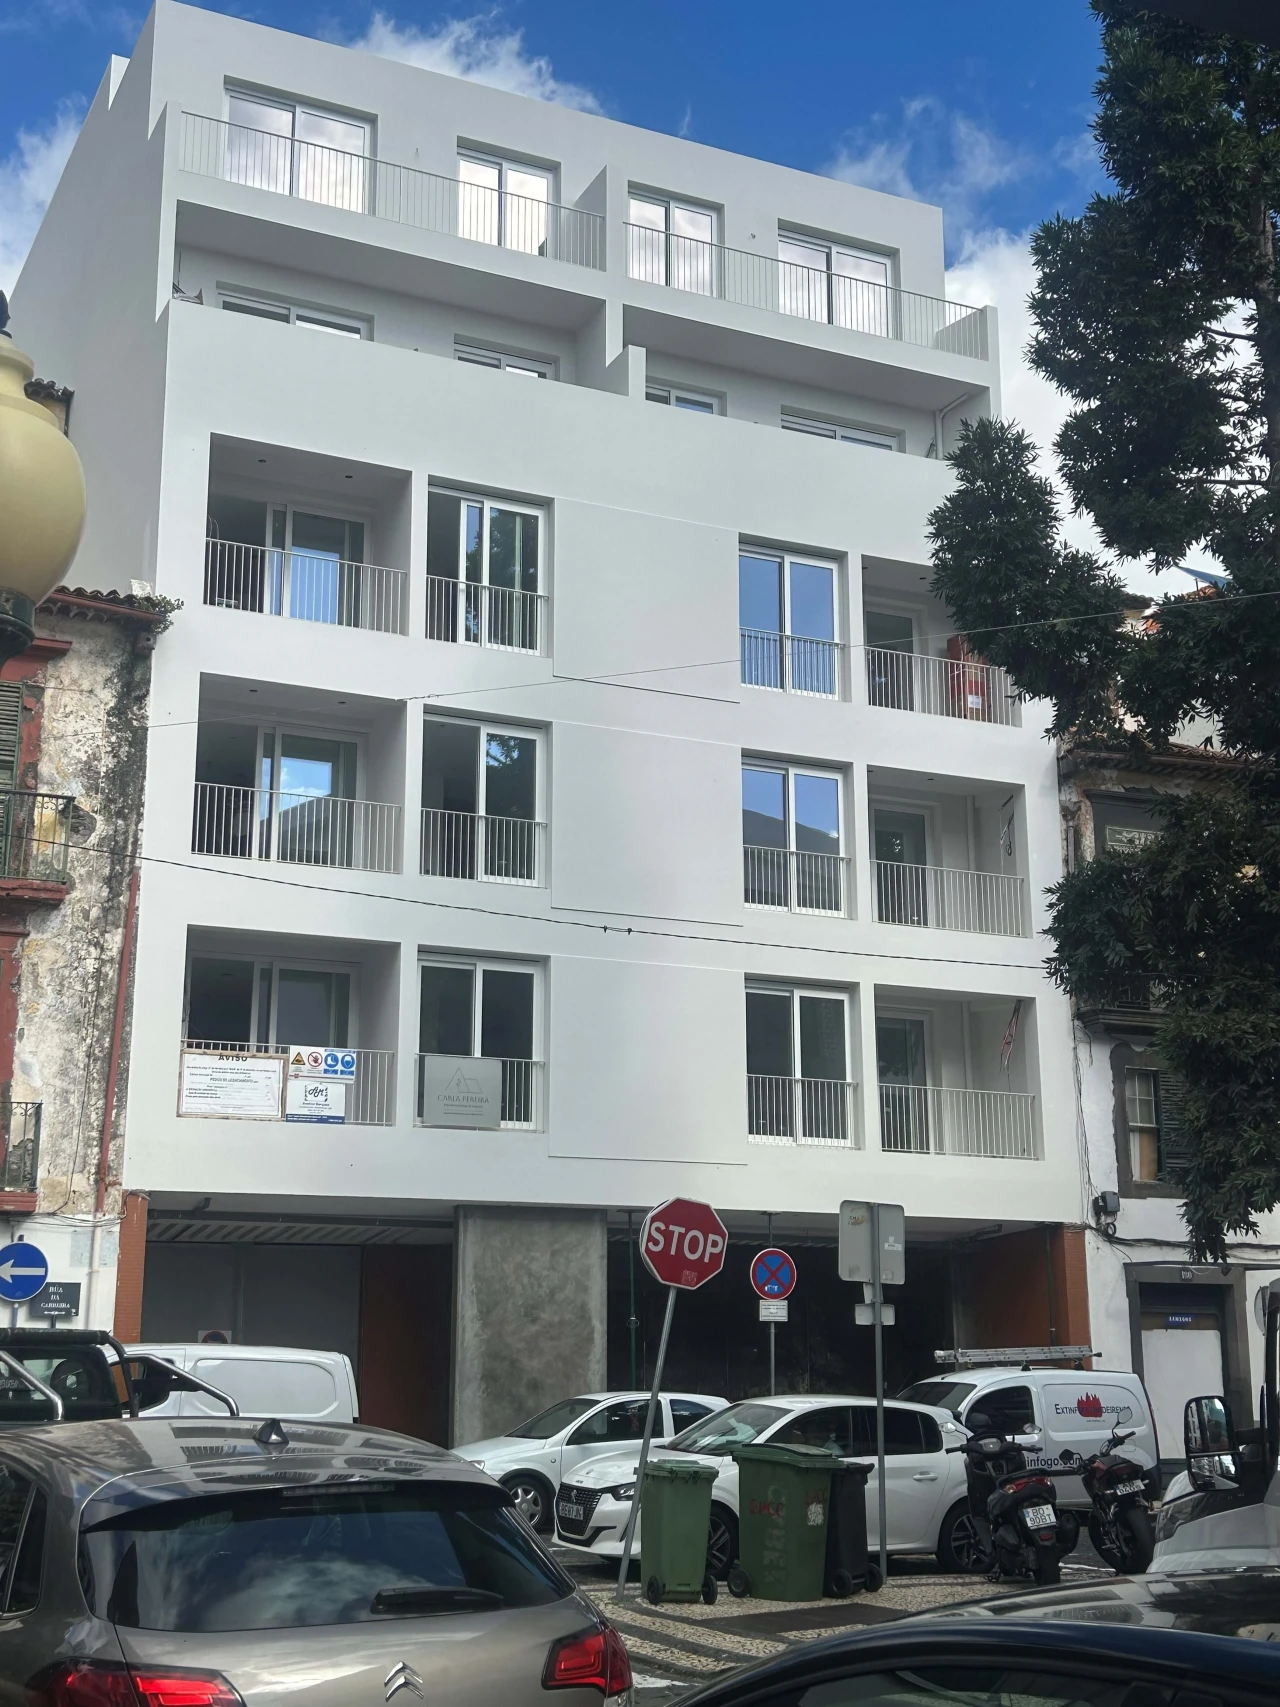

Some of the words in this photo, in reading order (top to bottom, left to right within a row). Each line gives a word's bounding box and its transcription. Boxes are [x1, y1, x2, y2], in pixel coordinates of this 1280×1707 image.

[437, 1094, 461, 1102] CARLA
[462, 1096, 490, 1104] PEREIRA
[647, 1221, 724, 1263] STOP
